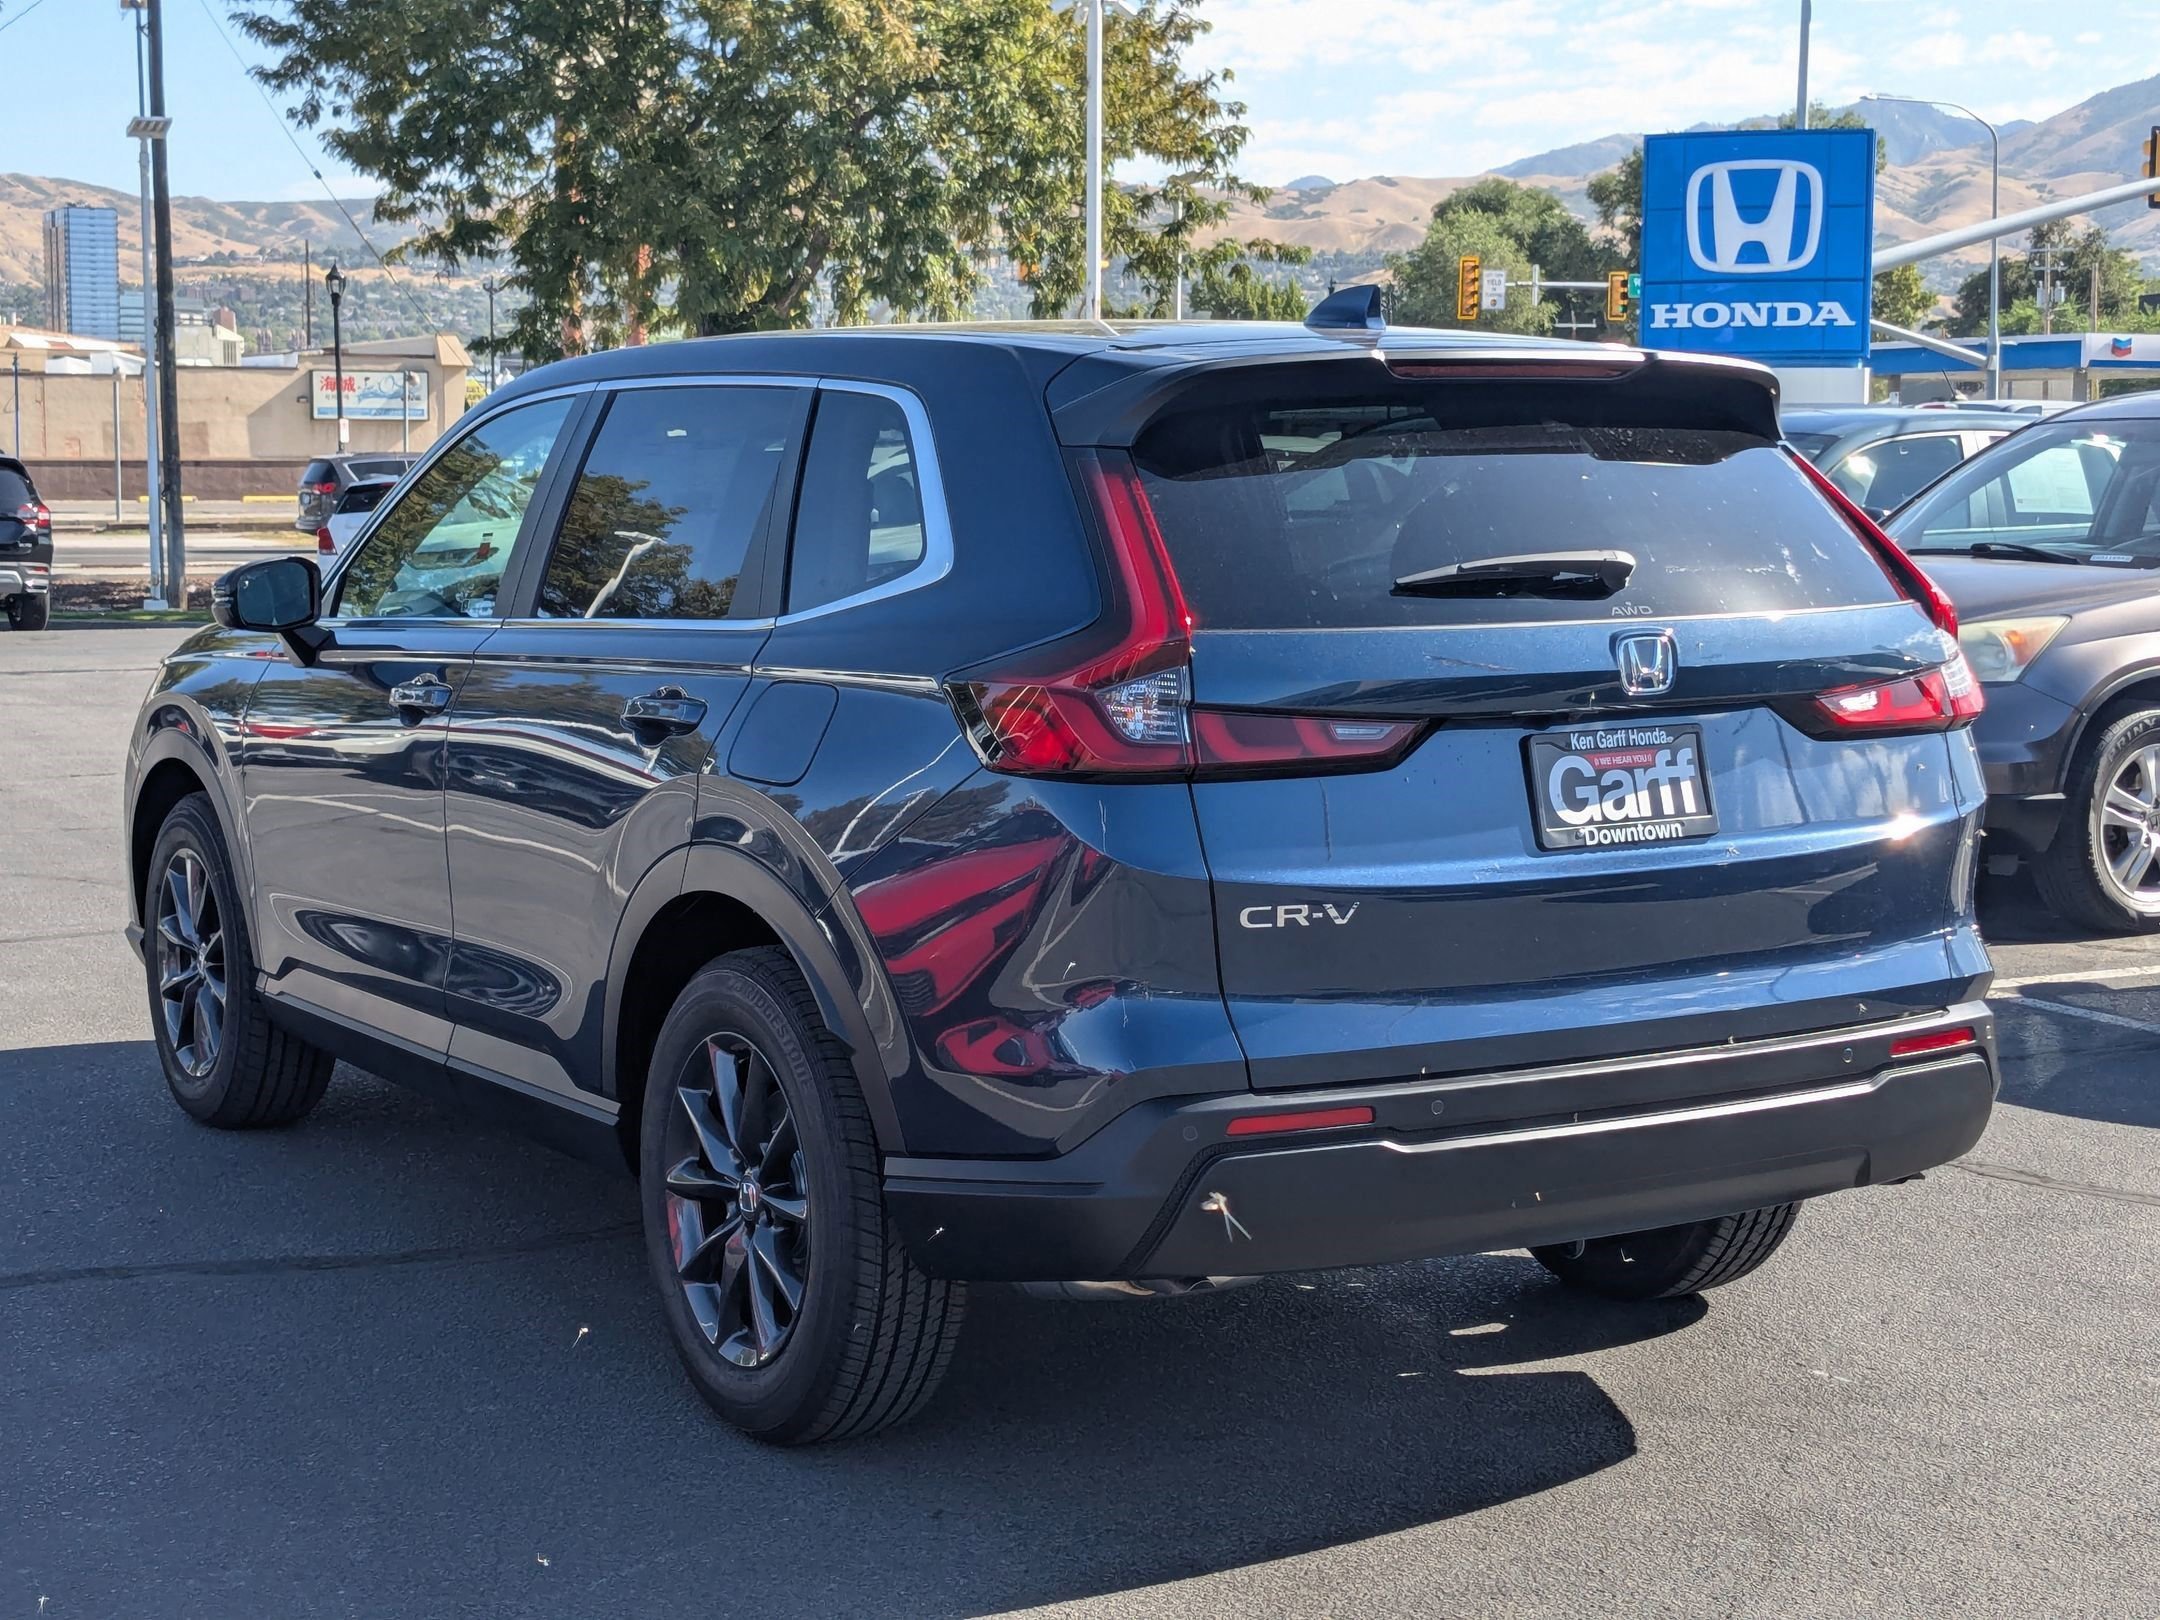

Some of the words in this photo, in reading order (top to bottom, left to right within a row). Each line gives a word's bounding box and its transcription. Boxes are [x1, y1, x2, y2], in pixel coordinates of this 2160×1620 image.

[1650, 301, 1856, 328] HONDA
[1612, 605, 1653, 616] AWD
[1570, 732, 1594, 750] Ken
[1596, 729, 1626, 749] Garff
[1628, 727, 1668, 746] Honda
[1599, 756, 1611, 766] WE
[1612, 755, 1632, 765] HEAR
[1632, 753, 1647, 763] YOU
[1549, 748, 1696, 825] Garff
[1585, 822, 1683, 846] Downtown
[1240, 901, 1360, 928] CR-V
